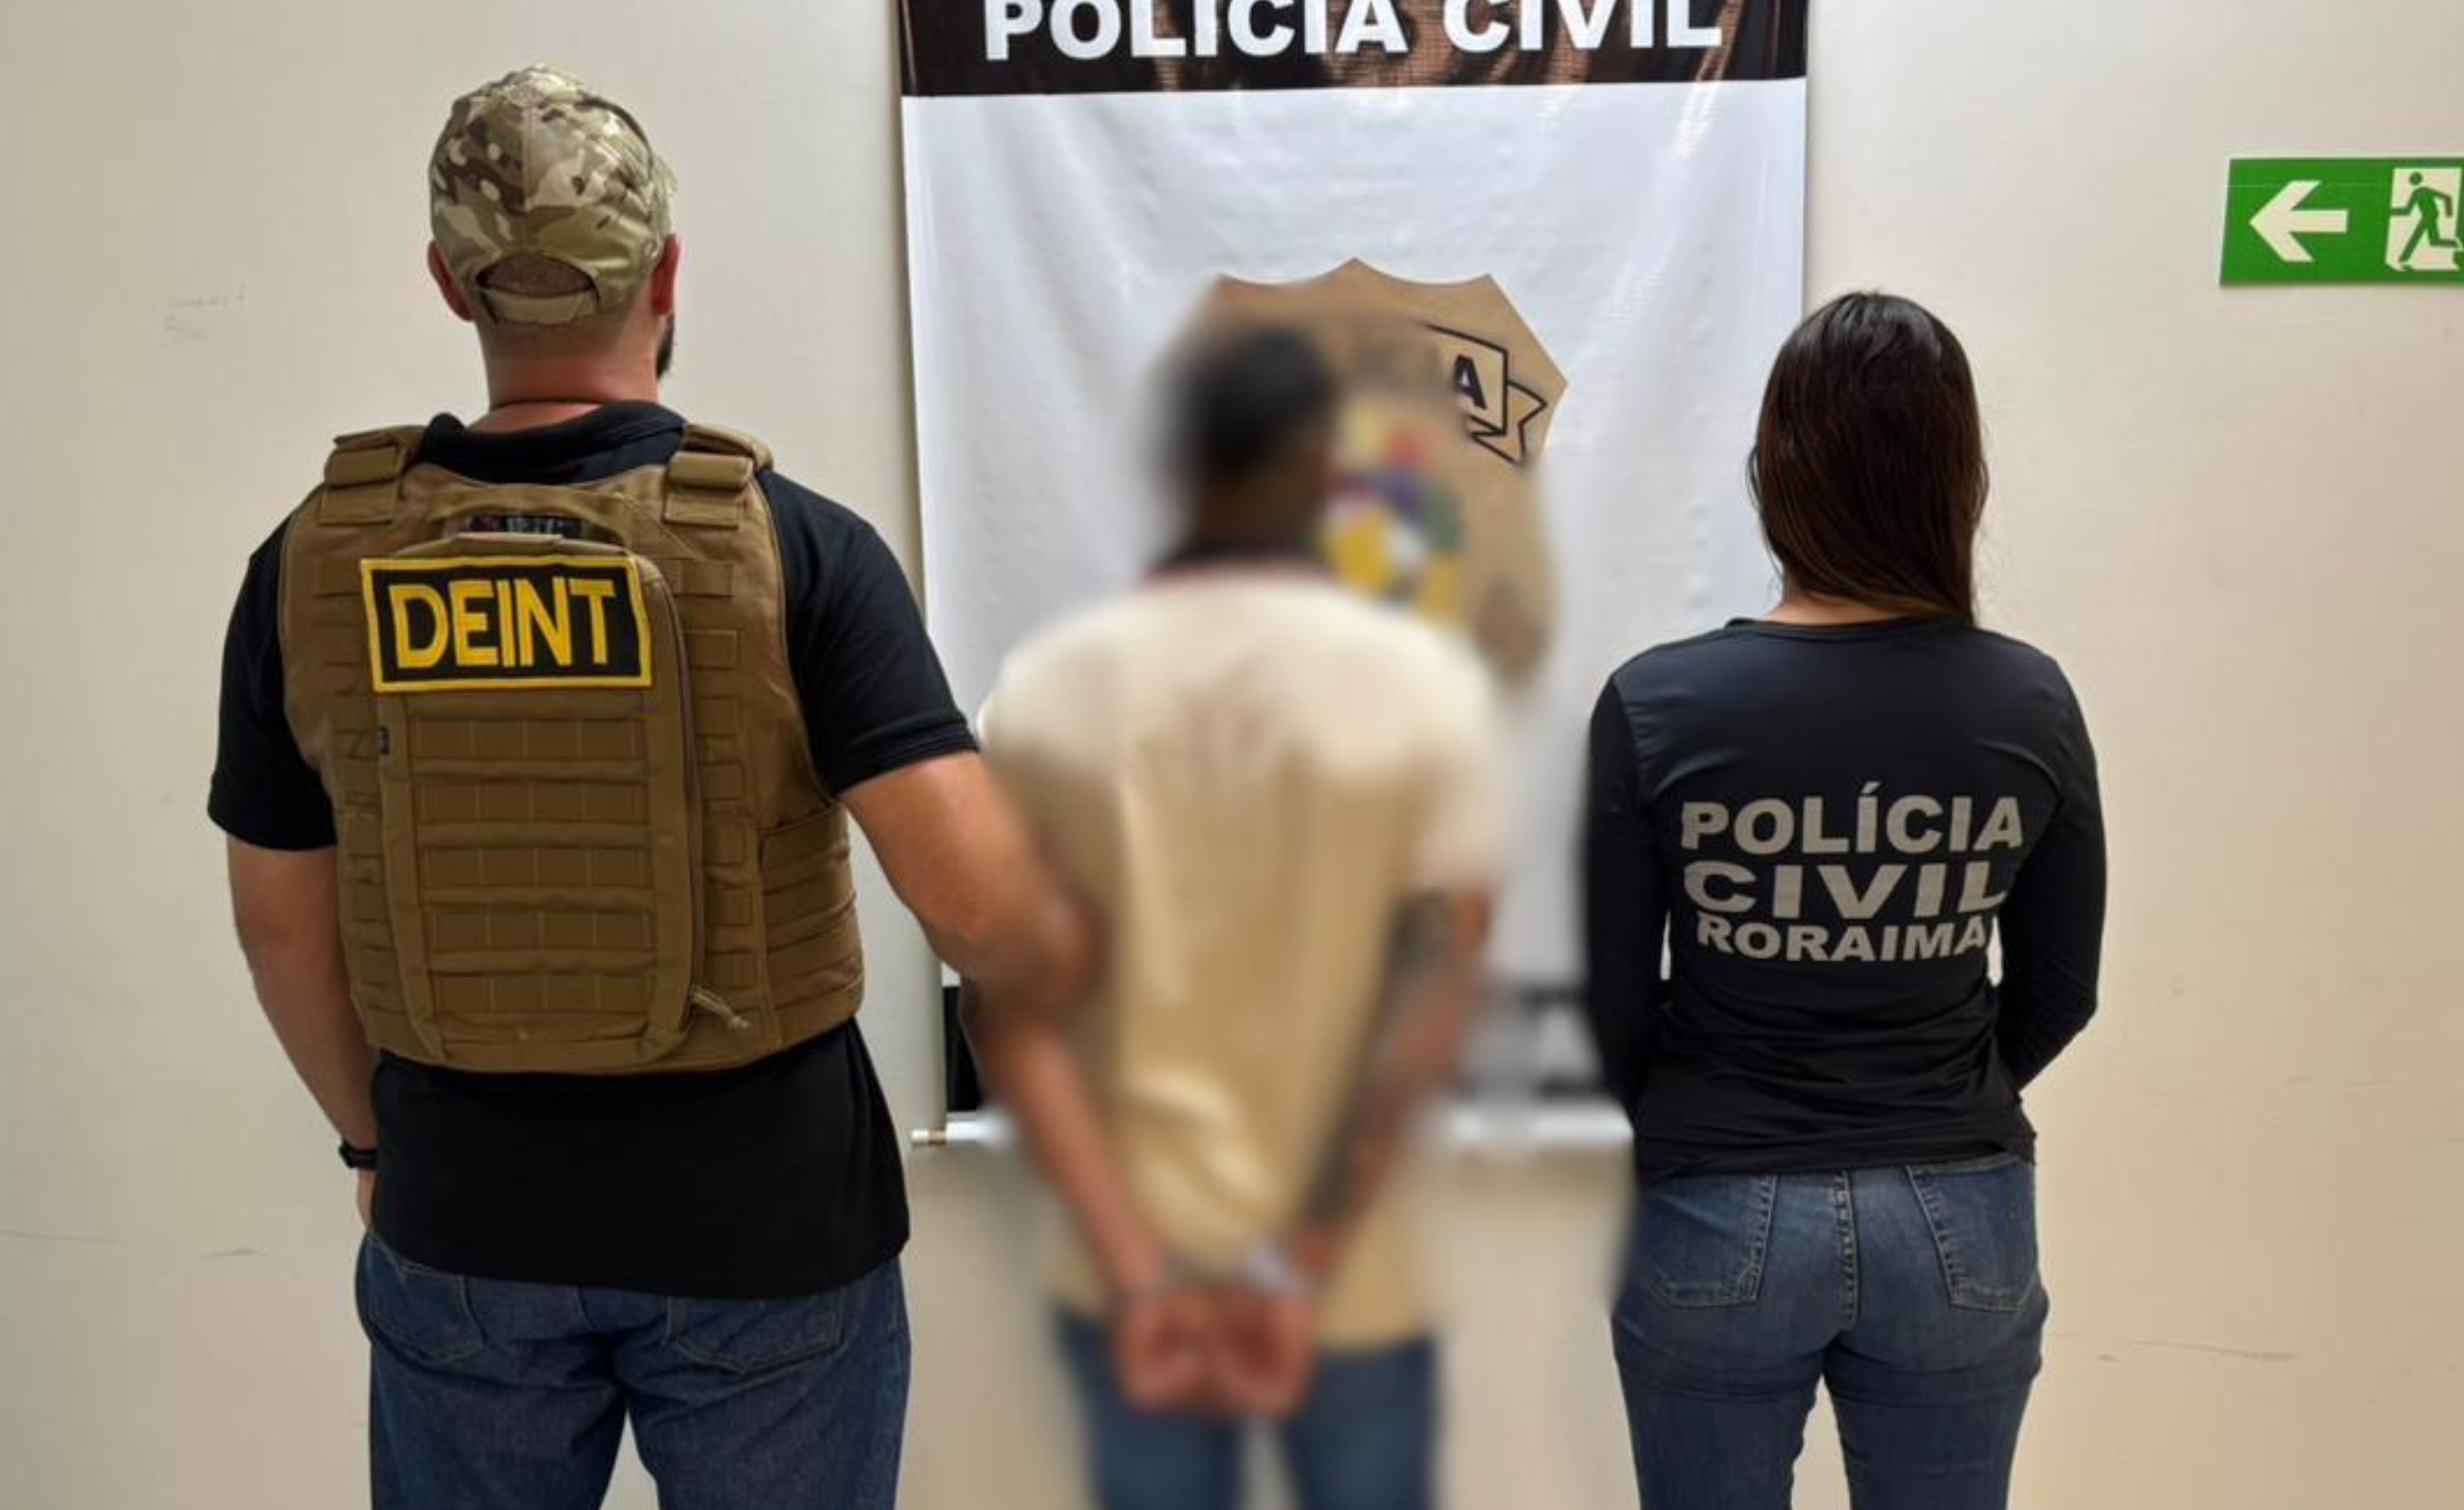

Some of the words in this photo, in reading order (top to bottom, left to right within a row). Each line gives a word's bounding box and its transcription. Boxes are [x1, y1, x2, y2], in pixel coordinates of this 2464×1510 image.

[1443, 0, 1723, 53] CIVIL
[388, 577, 617, 669] DEINT
[1681, 780, 2024, 854] POLÍCIA
[1684, 860, 2007, 920] CIVIL
[1697, 911, 1987, 962] RORAIMA
